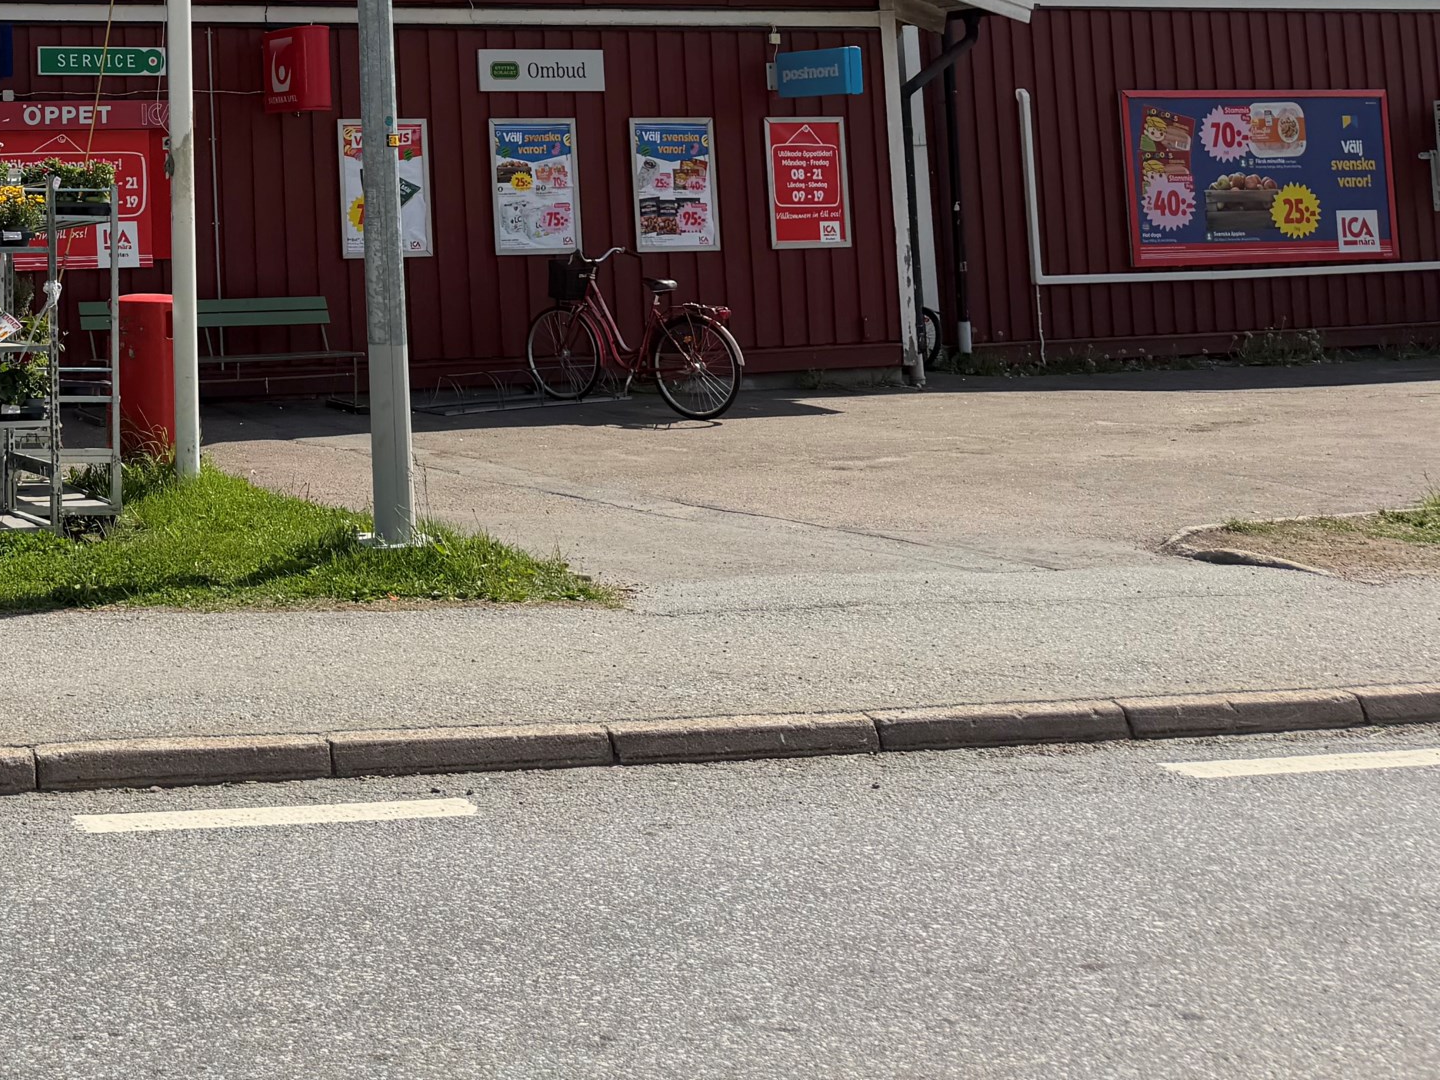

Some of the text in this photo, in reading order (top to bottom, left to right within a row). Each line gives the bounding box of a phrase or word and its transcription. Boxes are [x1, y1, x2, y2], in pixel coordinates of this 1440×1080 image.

[57, 54, 136, 68] SERVICE
[527, 62, 587, 79] Ombud
[782, 64, 839, 83] postnord
[22, 104, 112, 126] ÖPPET
[503, 132, 561, 144] Välj svenska
[642, 131, 700, 143] Välj svenska
[1210, 122, 1249, 148] 70:-
[517, 144, 547, 154] varor!
[657, 144, 686, 154] varor!
[1341, 139, 1363, 156] Välj
[782, 158, 807, 167] Måndag
[810, 159, 829, 167] Fredag
[1330, 157, 1376, 171] svenska
[791, 168, 805, 180] 08
[812, 168, 823, 180] 21
[1337, 174, 1372, 187] varor!
[126, 177, 138, 189] 21
[808, 181, 828, 189] Söndag
[126, 195, 138, 208] 19
[792, 190, 806, 202] 09
[813, 190, 824, 202] 19
[1147, 195, 1152, 205] 2
[1153, 190, 1194, 216] 40:-
[1282, 198, 1316, 224] 25:-
[546, 212, 568, 226] 75:-
[683, 211, 706, 226] 95:-
[823, 224, 837, 233] ICA
[1341, 217, 1375, 238] ICA
